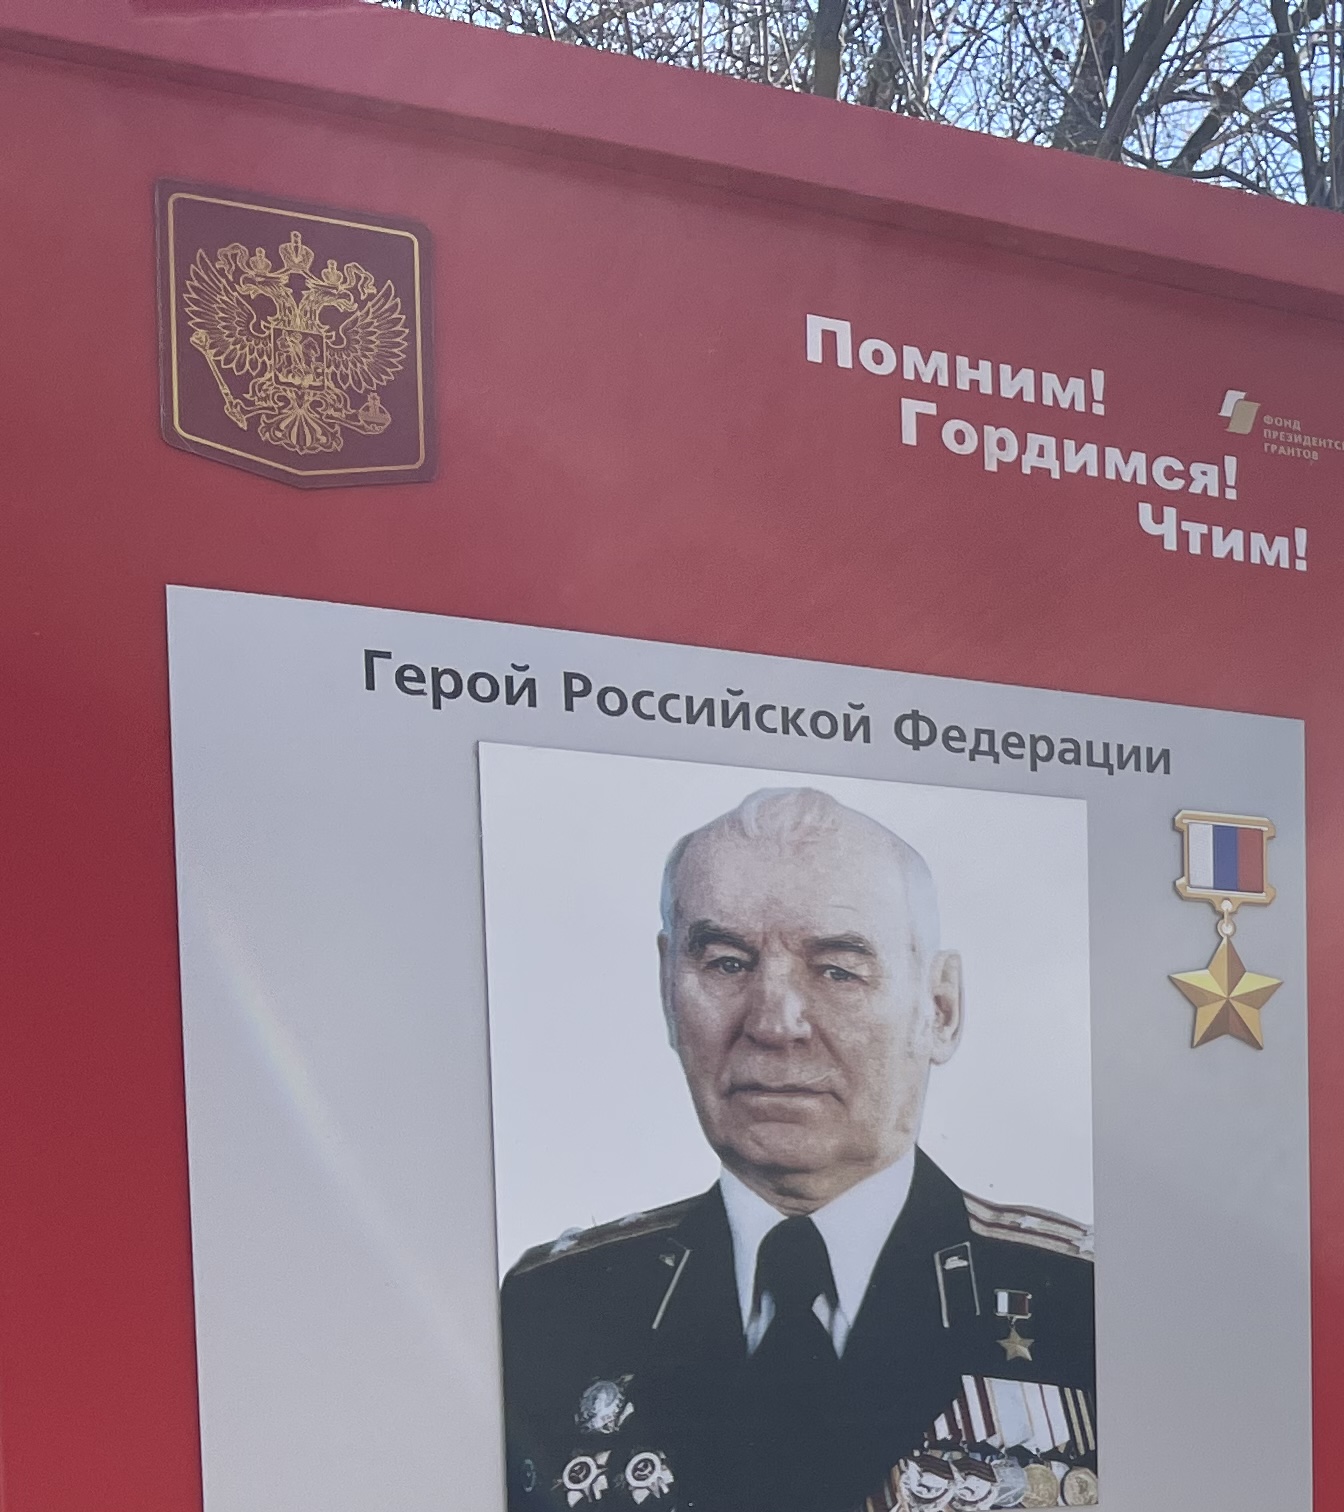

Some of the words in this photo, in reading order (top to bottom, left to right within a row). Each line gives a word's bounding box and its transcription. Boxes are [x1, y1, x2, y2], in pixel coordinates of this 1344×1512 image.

[806, 314, 1105, 415] Помним!
[900, 397, 1238, 500] Гордимся!
[1263, 415, 1302, 432] ФОНД
[1263, 442, 1319, 461] ГРАНТОВ
[1137, 502, 1307, 571] Чтим!
[362, 648, 539, 709] Герой
[563, 671, 872, 745] Российской
[893, 709, 1173, 776] Федерации
